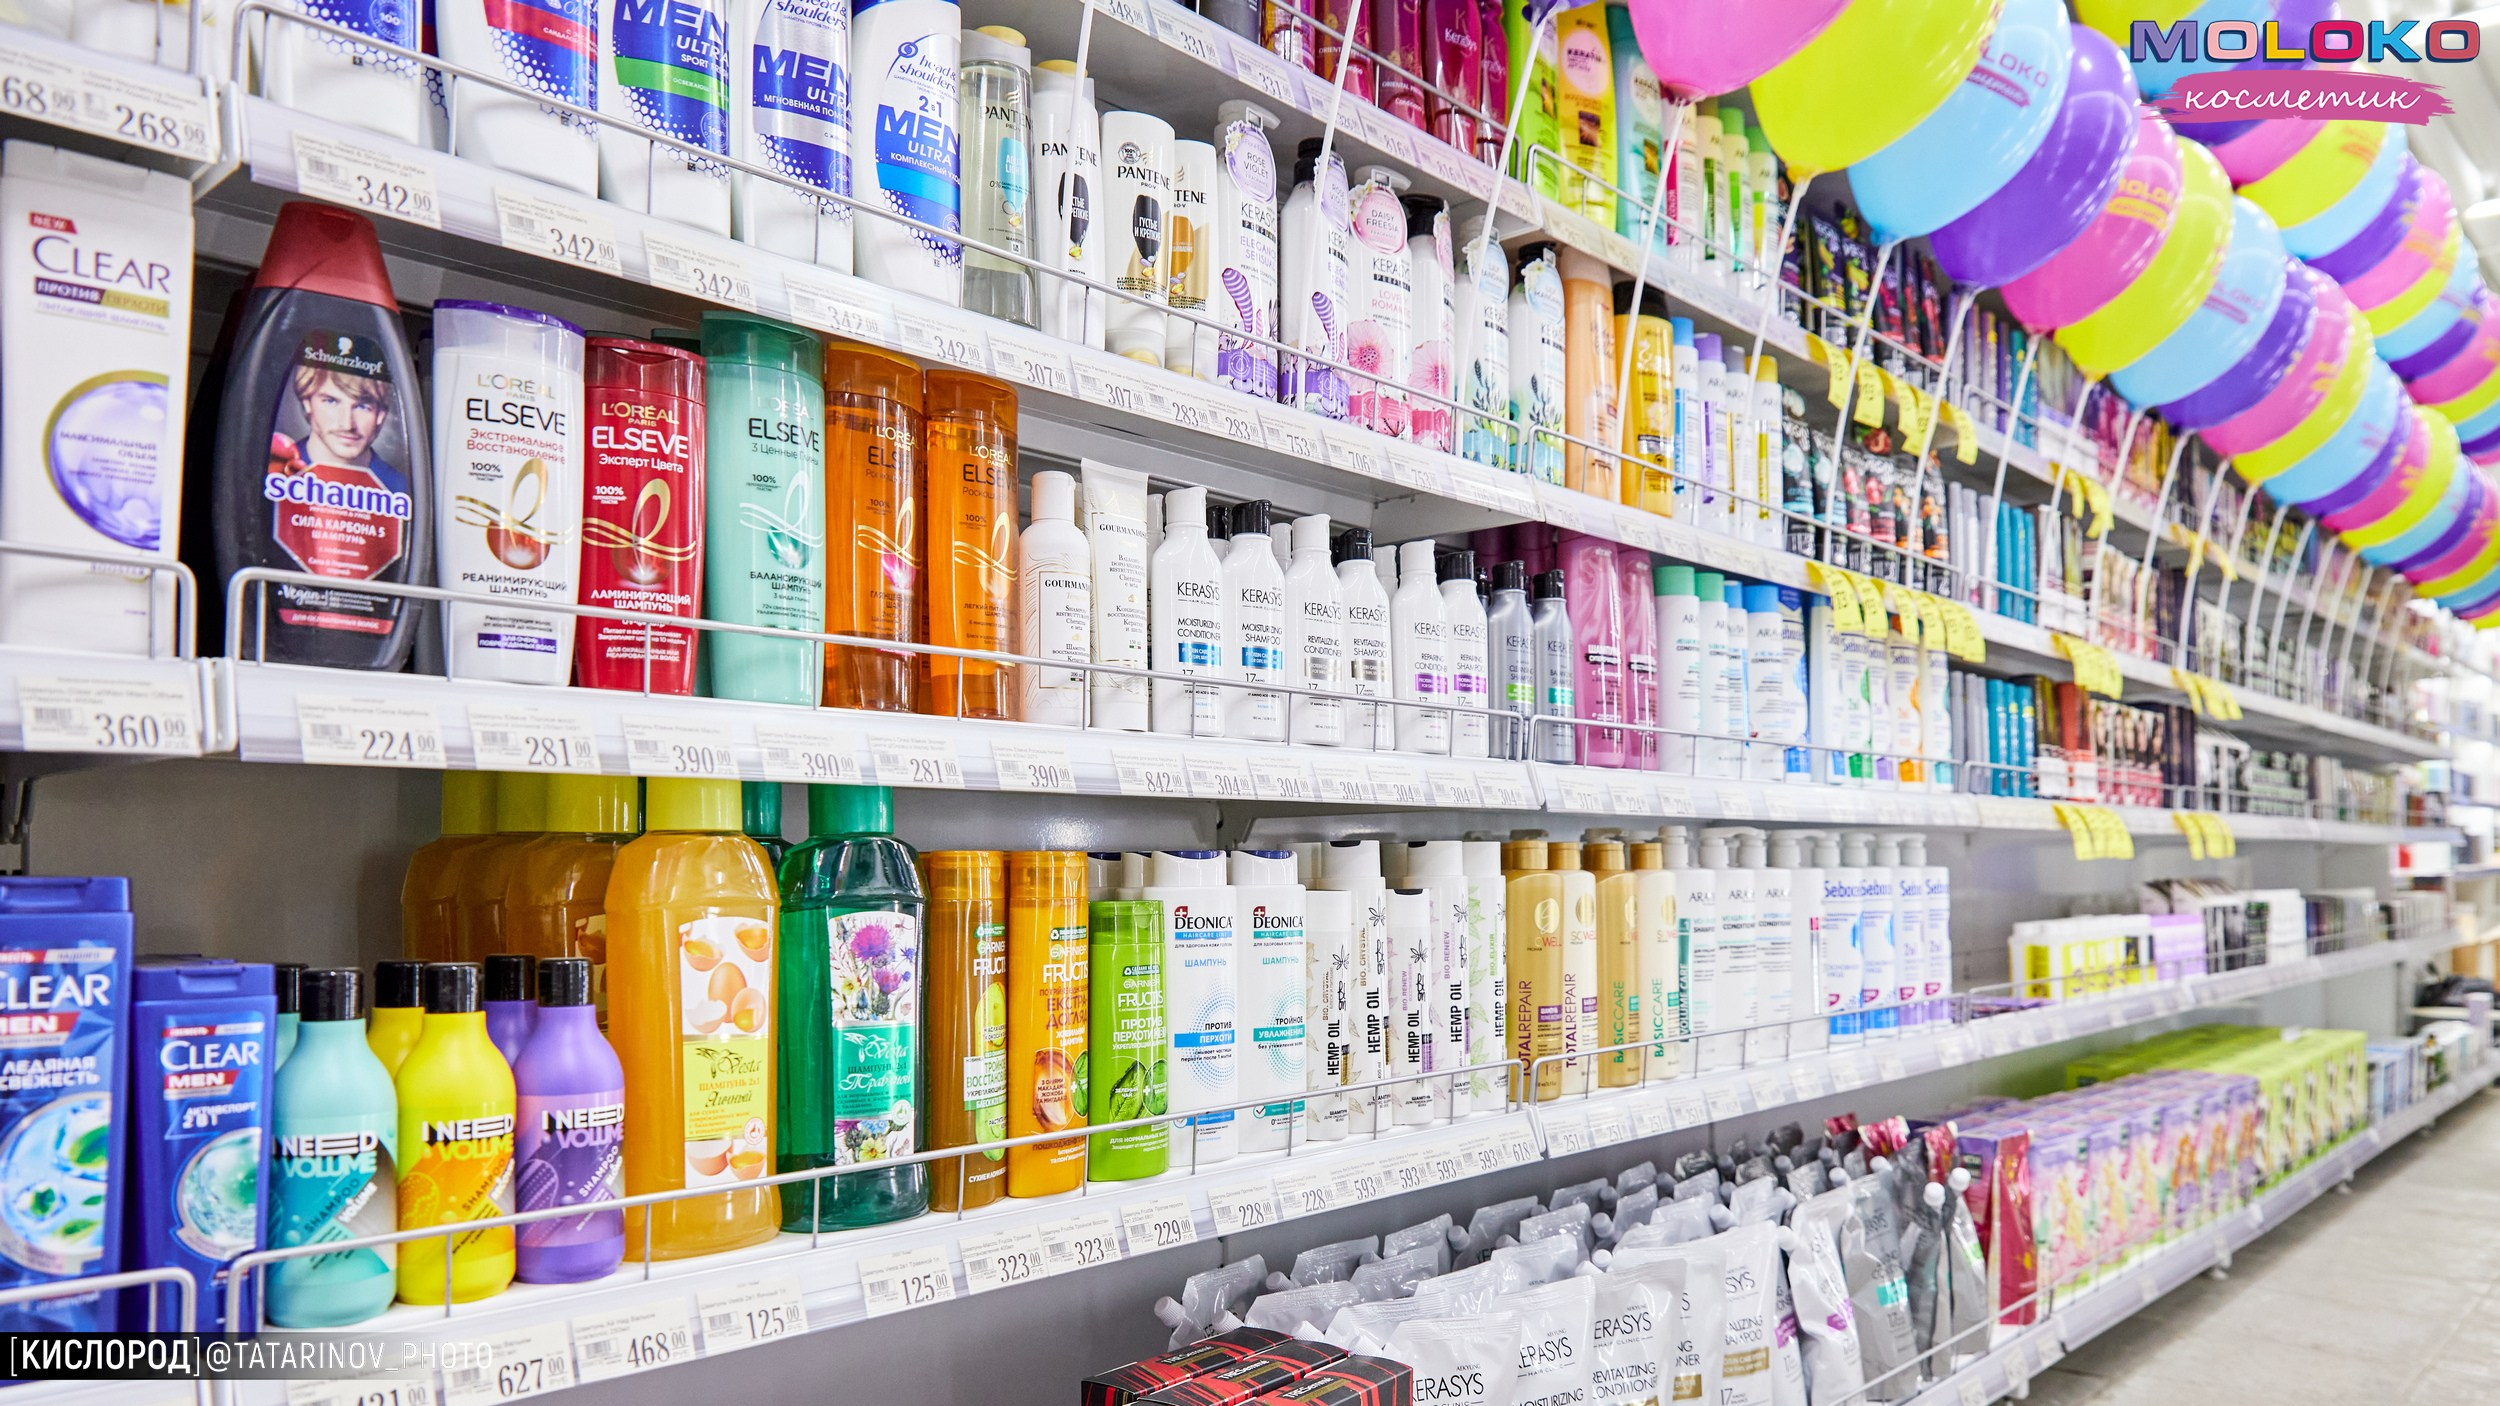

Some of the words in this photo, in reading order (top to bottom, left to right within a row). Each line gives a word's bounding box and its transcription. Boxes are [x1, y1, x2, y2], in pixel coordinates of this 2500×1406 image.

[775, 1, 847, 31] shoulders
[681, 54, 708, 69] SPORT
[899, 62, 956, 94] shoulders
[764, 93, 820, 114] МГНОВЕННАЯ
[115, 103, 182, 149] 268
[890, 151, 948, 175] КОМПЛЕКСНЫЙ
[907, 139, 952, 168] ULTRA
[1247, 151, 1266, 169] ROSE
[1117, 165, 1171, 191] PANTENE
[1243, 161, 1269, 181] VIOLET
[356, 174, 411, 211] 342
[34, 216, 68, 231] NEW
[1139, 216, 1158, 231] ГУСТЫЕ
[1366, 217, 1399, 233] FREESIA
[1370, 210, 1395, 223] DAISY
[550, 226, 598, 265] 342
[32, 235, 171, 294] CLEAR
[37, 280, 100, 303] ПРОТИВ
[693, 267, 735, 302] 342
[828, 304, 862, 337] 342
[303, 346, 385, 375] Schwarzkopf
[934, 334, 969, 365] 342
[1025, 359, 1052, 391] 307
[1105, 382, 1132, 409] 307
[466, 398, 567, 436] ELSEVE
[601, 401, 680, 425] L'ORÉAL
[1172, 400, 1199, 427] 283
[469, 427, 565, 452] Экстремальное
[748, 416, 820, 453] ELSEVE
[1225, 415, 1250, 441] 283
[466, 438, 566, 465] Восстановление
[591, 425, 690, 459] ELSEVE
[760, 444, 799, 461] Ценные
[1287, 433, 1310, 458] 753
[598, 453, 650, 468] Эксперт
[650, 458, 684, 474] Цвета
[1348, 450, 1370, 474] 706
[265, 474, 411, 519] schauma
[290, 513, 324, 529] СИЛА
[324, 519, 377, 536] КАРБОНА
[311, 529, 366, 546] ШАМПУНЬ
[461, 572, 568, 592] РЕАНИМИРУЮЩИЙ
[489, 584, 549, 599] ШАМПУНЬ
[1177, 581, 1221, 601] KERASYS
[590, 588, 692, 607] ЛАМИНИРУЮЩИЙ
[613, 598, 674, 613] ШАМПУНЬ
[1241, 588, 1283, 607] KERASYS
[1304, 601, 1342, 620] KERASYS
[1349, 606, 1387, 624] KERASYS
[1177, 617, 1221, 630] MOISTURIZING
[1177, 628, 1221, 641] CONDITIONER
[1245, 633, 1281, 645] SHAMPOO
[94, 713, 160, 749] 360
[361, 729, 414, 762] 224
[525, 735, 572, 767] 281
[672, 744, 715, 775] 390
[802, 751, 839, 778] 390
[910, 757, 944, 784] 281
[1028, 763, 1060, 789] 390
[1145, 770, 1173, 793] 842
[1217, 773, 1240, 796] 304
[1276, 776, 1299, 799] 304
[1341, 779, 1362, 801] 304
[1174, 915, 1233, 930] DEONICA
[1253, 915, 1304, 930] DEONICA
[1043, 961, 1089, 984] FRUCTIS
[1184, 958, 1227, 968] ШАМПУНЬ
[1117, 990, 1164, 1008] FRUCTIS
[1366, 987, 1380, 1012] OIL
[1449, 979, 1462, 1001] OIL
[1047, 995, 1087, 1012] ЕКСТРА
[1046, 1009, 1088, 1031] ДОГЛЯД
[1121, 1016, 1163, 1031] ПРОТИВ
[1204, 1021, 1233, 1031] ПРОТИВ
[1275, 1015, 1303, 1026] ТРОЙНОЕ
[1327, 1019, 1340, 1040] OIL
[1407, 1009, 1419, 1029] OIL
[1450, 1005, 1462, 1043] HEMP
[1199, 1033, 1233, 1045] ПЕРХОТИ
[1258, 1027, 1304, 1039] УВЛАЖНЕНИЕ
[1367, 1017, 1381, 1054] HEMP
[160, 1039, 261, 1072] CLEAR
[1408, 1030, 1420, 1063] HEMP
[847, 1063, 893, 1076] ШАМПУНЬ
[1327, 1042, 1340, 1076] HEMP
[168, 1072, 226, 1090] MEN
[698, 1079, 747, 1093] ШАМПУНЬ
[438, 1132, 515, 1163] VOLUME
[557, 1123, 625, 1150] VOLUME
[1478, 1149, 1498, 1171] 593
[1512, 1142, 1531, 1162] 618
[283, 1150, 379, 1179] VOLUME
[1437, 1159, 1457, 1182] 593
[1354, 1175, 1377, 1201] 593
[1399, 1165, 1421, 1190] 593
[303, 1177, 361, 1234] SHAMPOO
[1302, 1188, 1326, 1213] 228
[1238, 1201, 1265, 1228] 228
[1153, 1219, 1182, 1247] 229
[1074, 1236, 1106, 1266] 323
[998, 1252, 1031, 1284] 323
[901, 1274, 935, 1306] 125
[746, 1306, 785, 1341] 125
[627, 1332, 671, 1368] 468
[498, 1357, 544, 1397] 627
[1216, 1359, 1270, 1380] TRESemmé
[1282, 1376, 1335, 1400] TRESemmé
